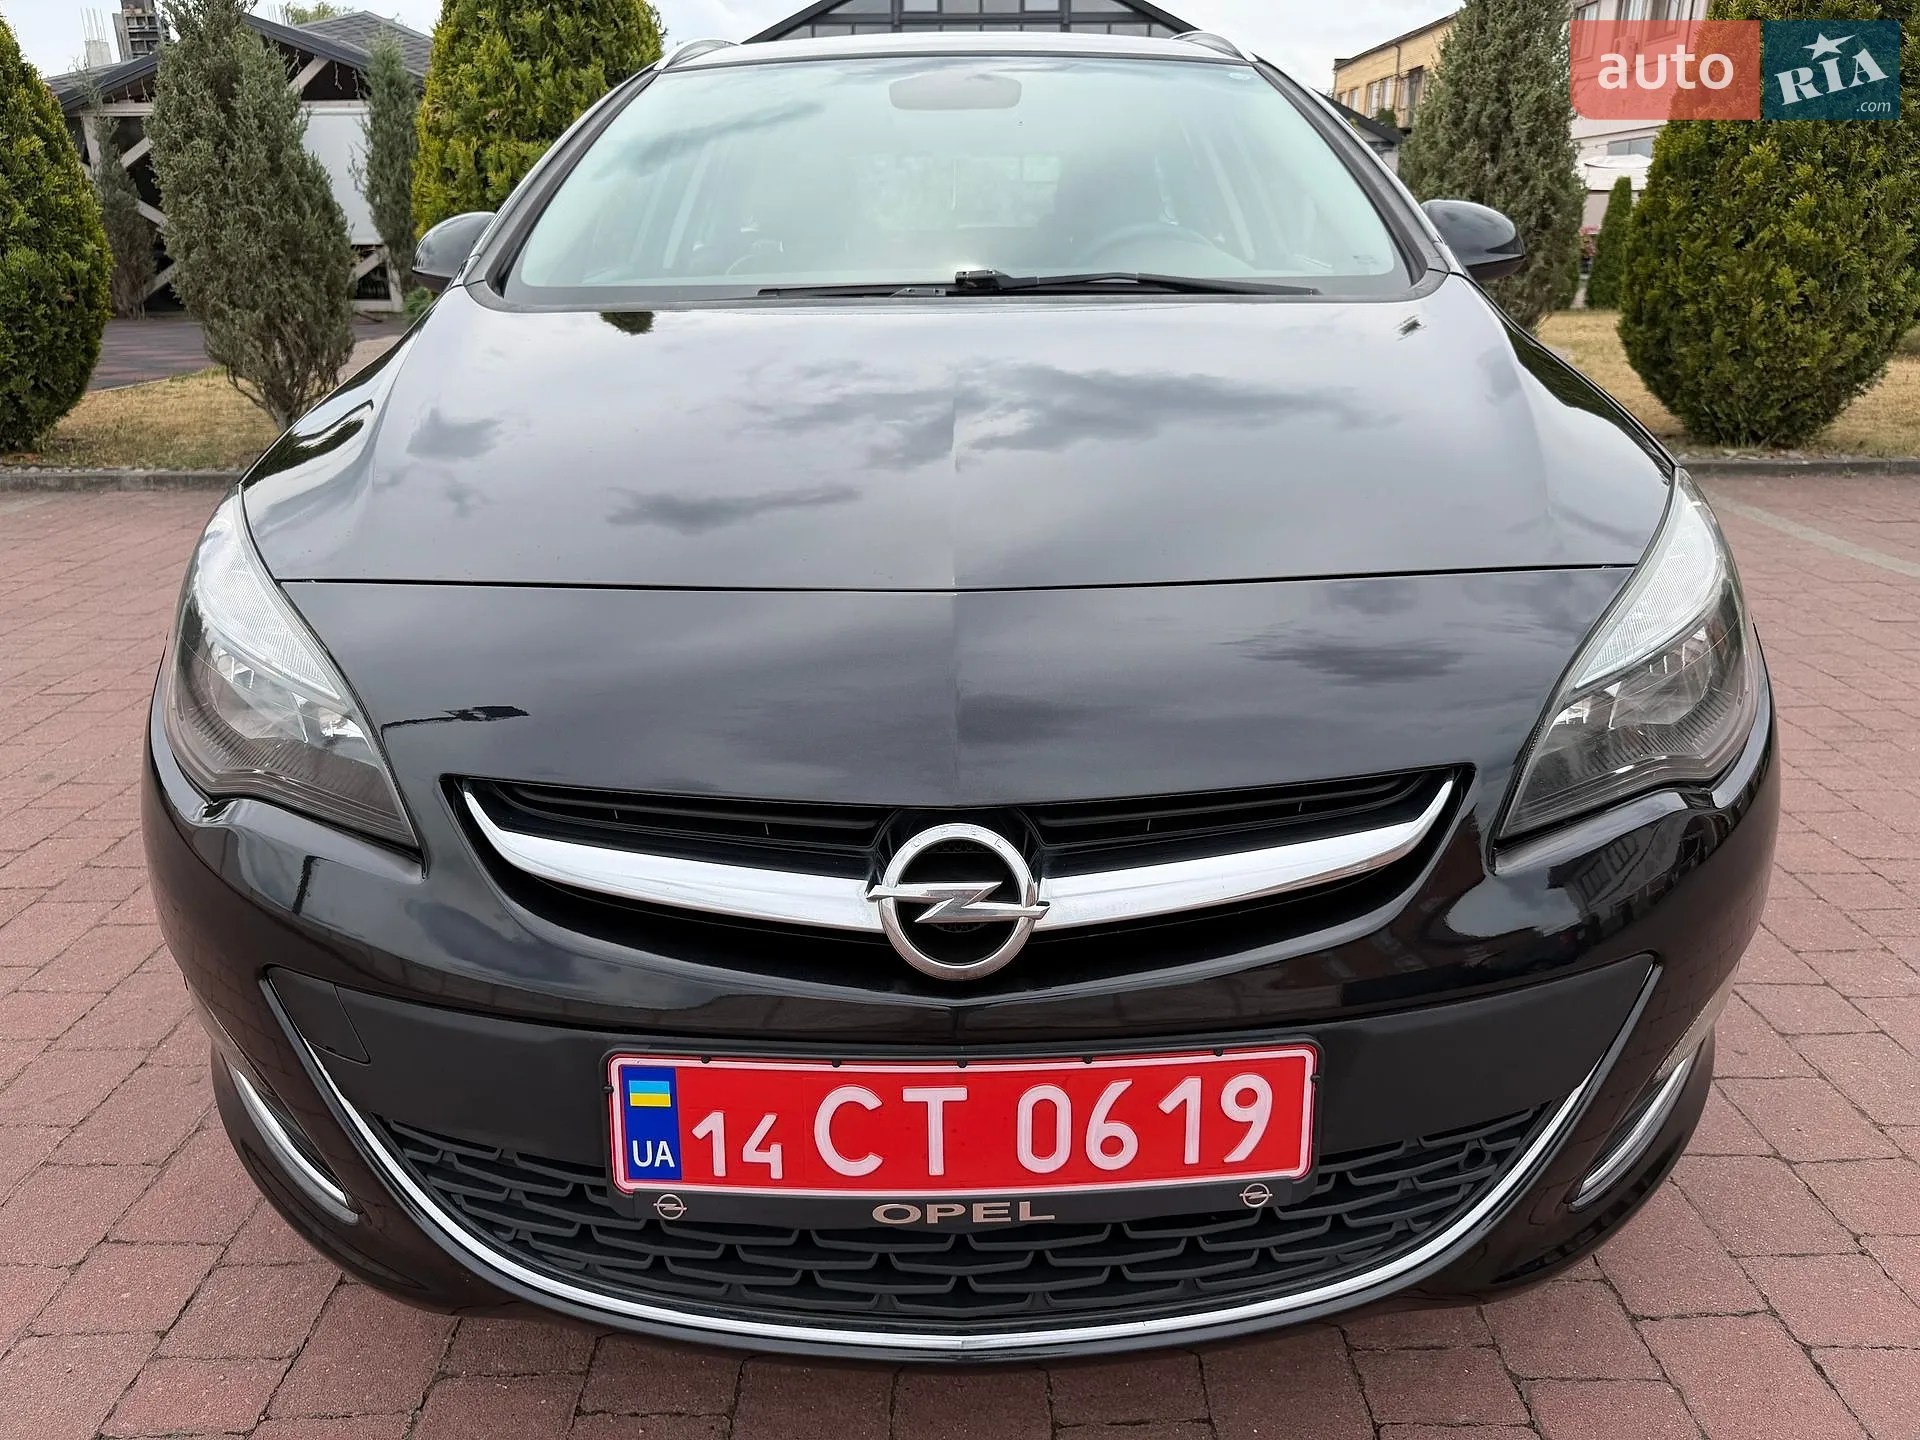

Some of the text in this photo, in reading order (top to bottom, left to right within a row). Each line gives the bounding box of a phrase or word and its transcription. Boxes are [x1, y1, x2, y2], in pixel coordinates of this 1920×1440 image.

[692, 1073, 1273, 1179] 14 CT 0619
[632, 1140, 675, 1168] UA
[872, 1201, 1056, 1225] OPEL
